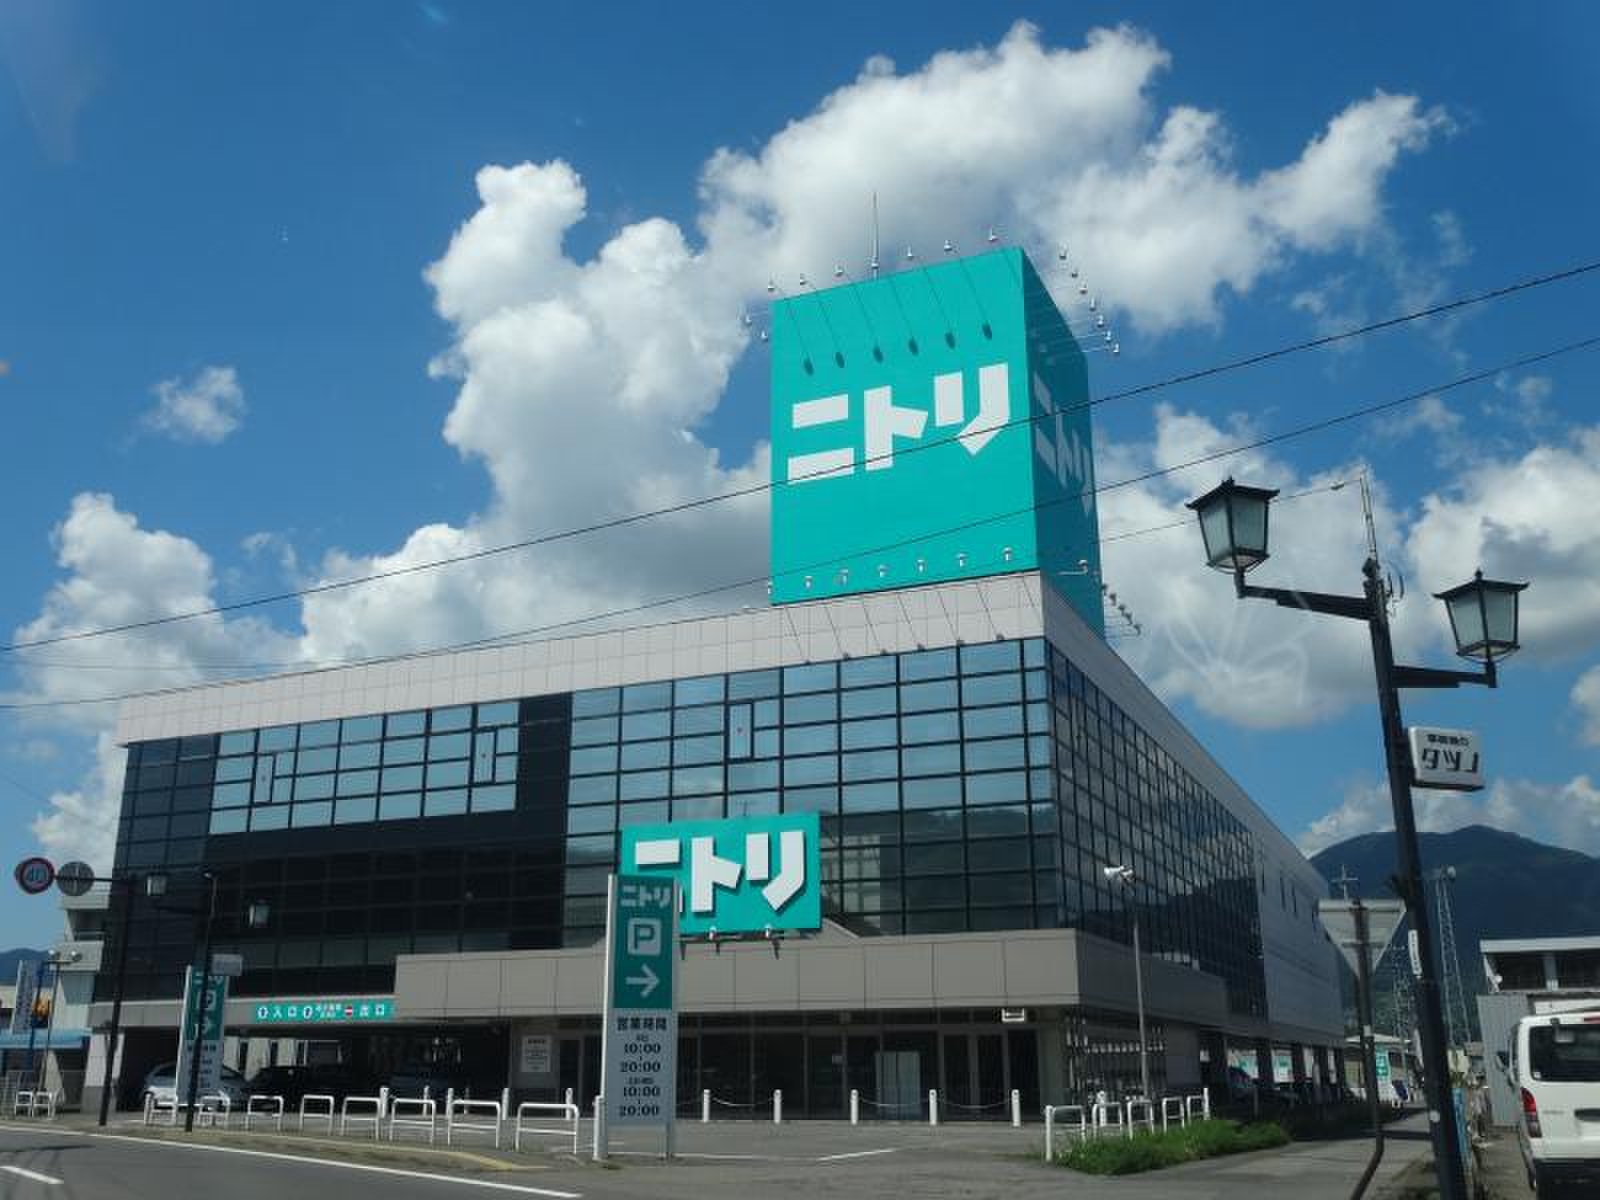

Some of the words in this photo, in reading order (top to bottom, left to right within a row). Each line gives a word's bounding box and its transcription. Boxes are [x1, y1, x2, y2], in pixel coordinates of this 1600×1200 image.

[787, 362, 1010, 485] ニトリ
[620, 884, 672, 908] ニトリ
[633, 923, 656, 950] P
[624, 1042, 662, 1054] 10:00
[620, 1061, 661, 1073] 20:00
[623, 1086, 661, 1097] 10:00
[619, 1104, 660, 1117] 20:00
